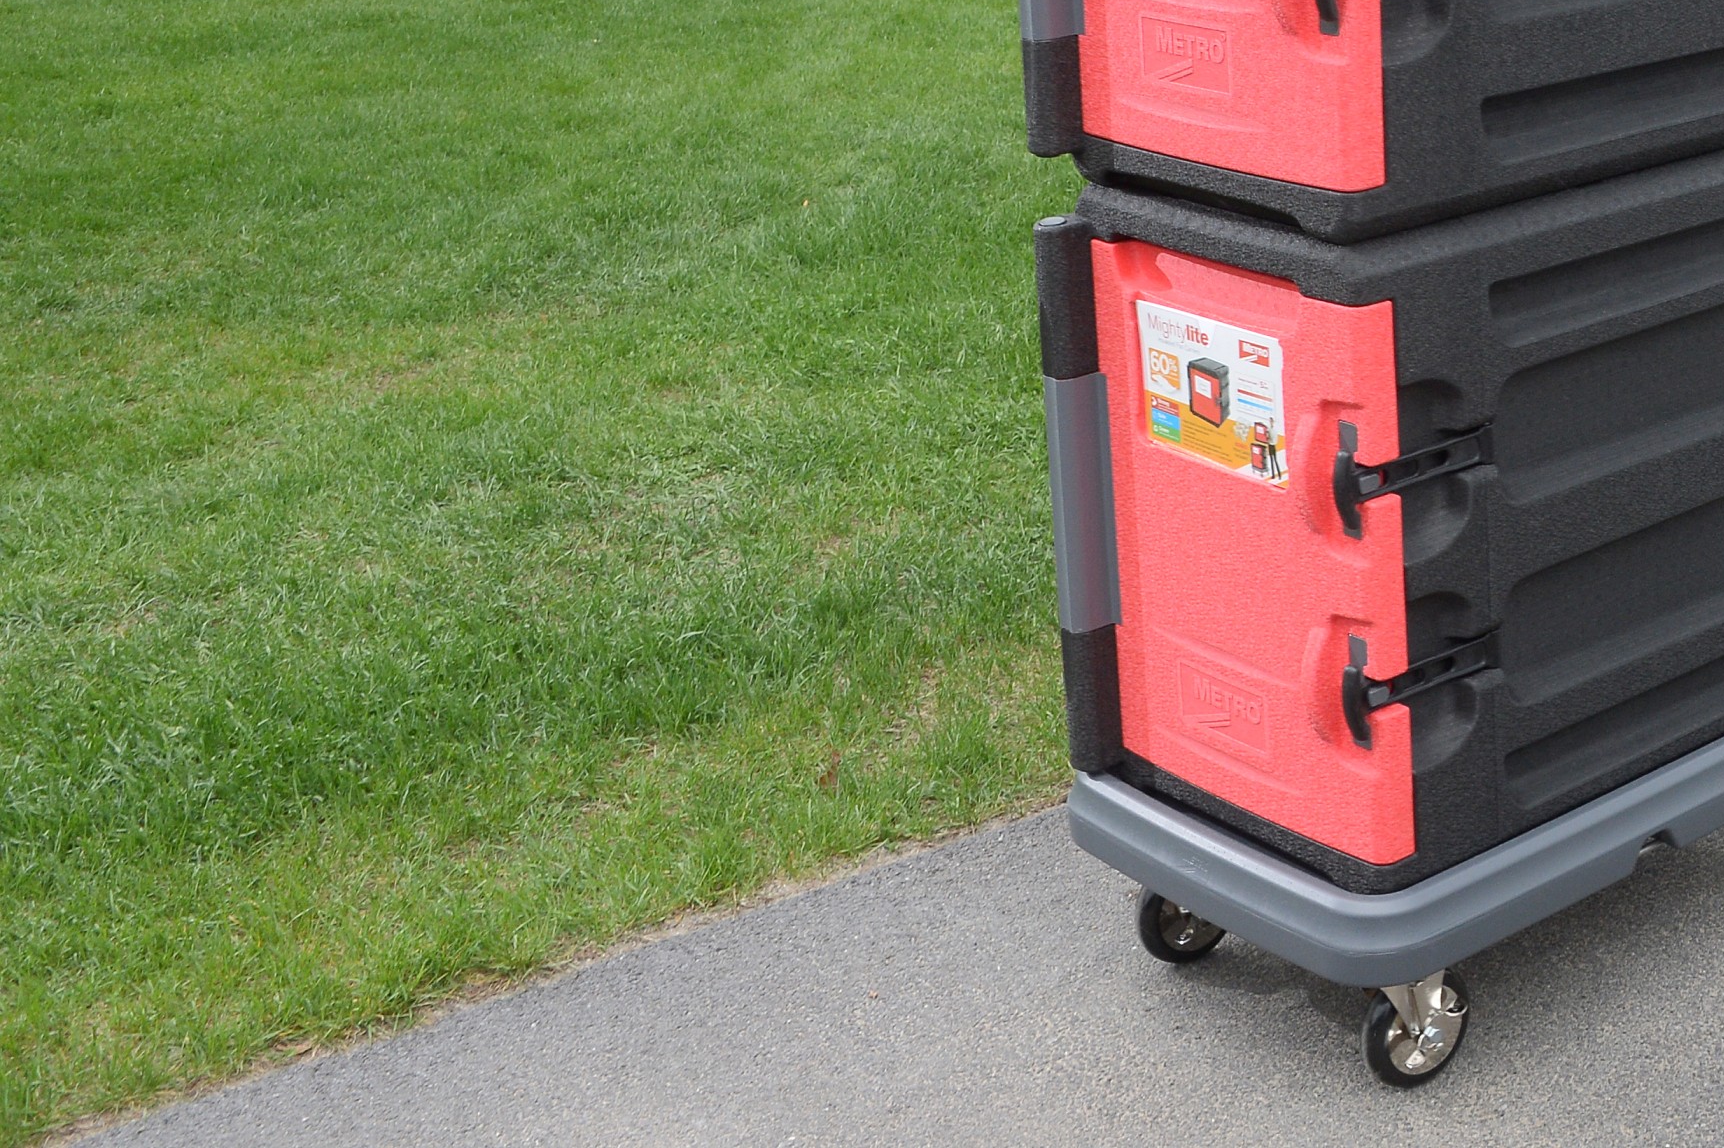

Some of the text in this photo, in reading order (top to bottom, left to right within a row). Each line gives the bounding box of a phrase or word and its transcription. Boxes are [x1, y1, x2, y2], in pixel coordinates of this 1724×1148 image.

[1155, 25, 1226, 64] METRO
[1147, 312, 1209, 347] Mightylite
[1150, 350, 1178, 375] 60%
[1192, 674, 1263, 726] METRO
